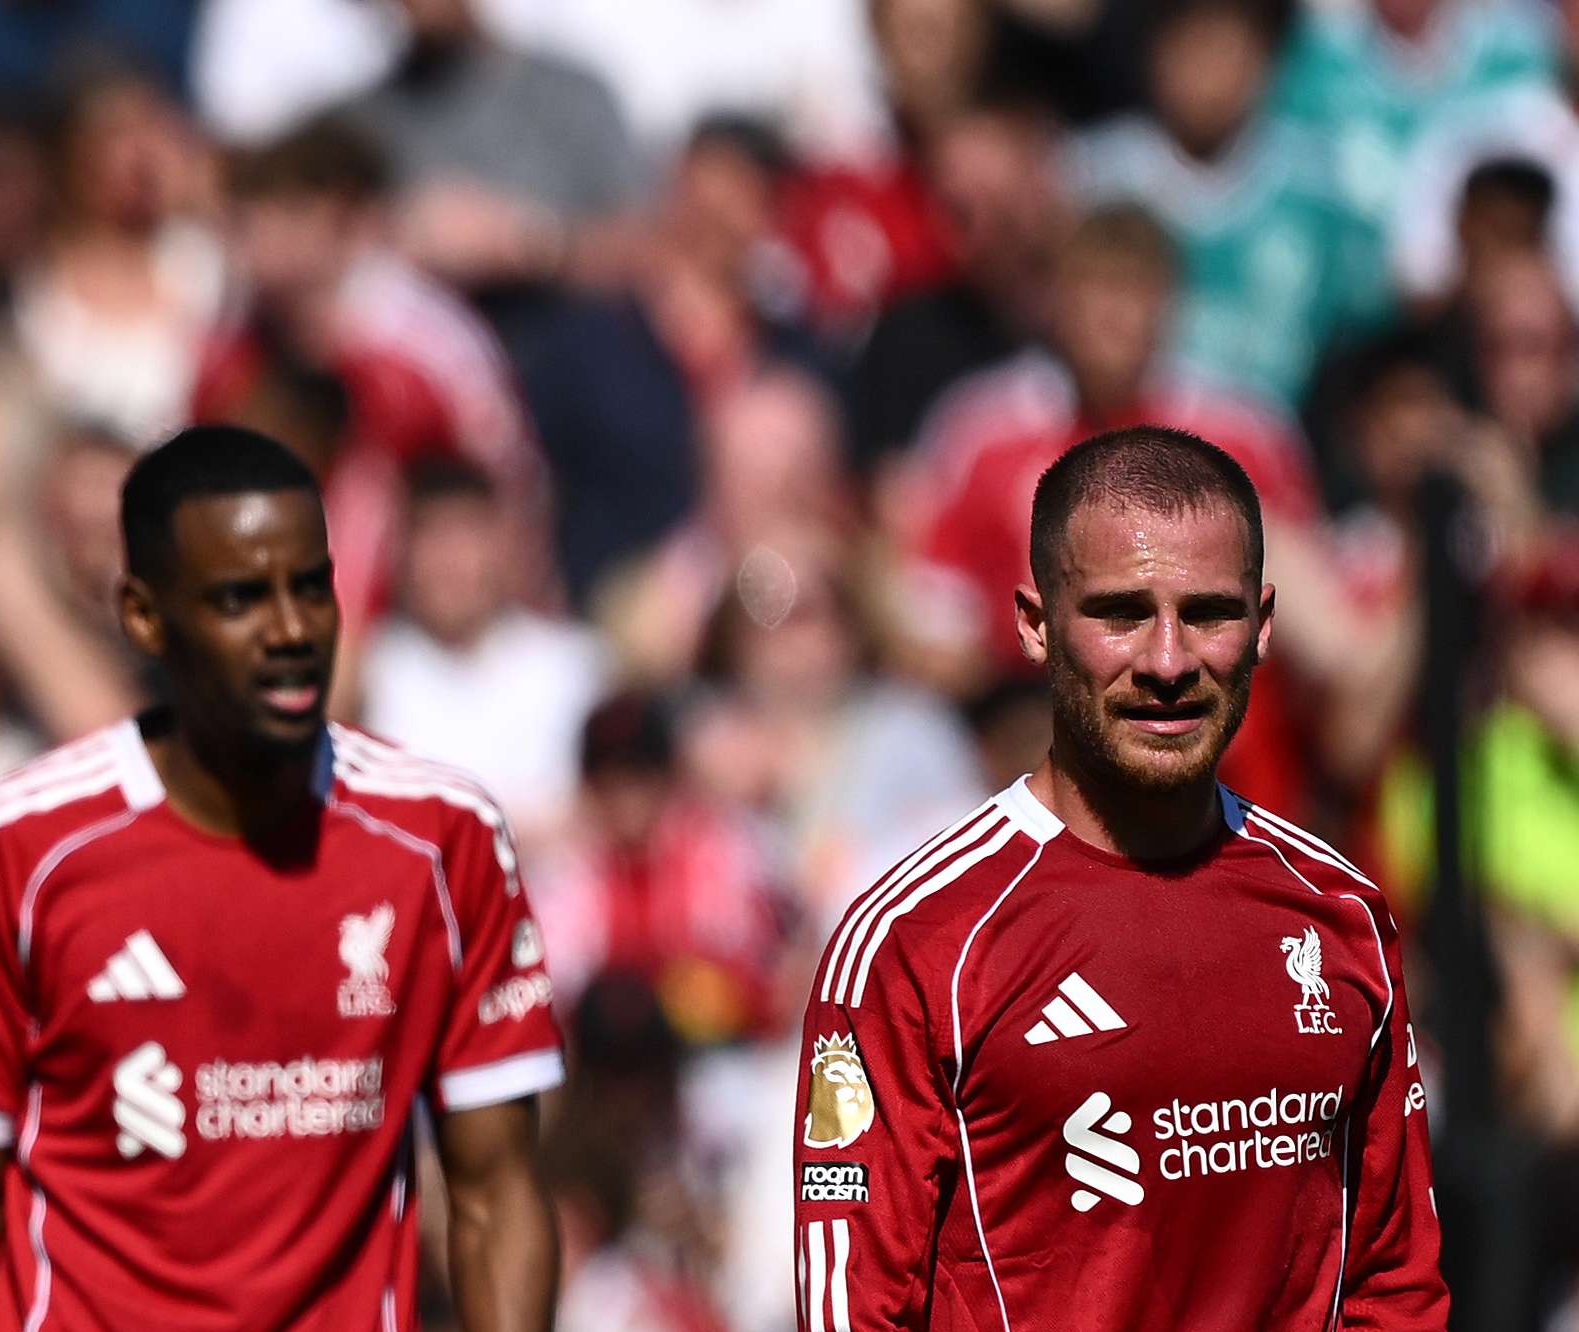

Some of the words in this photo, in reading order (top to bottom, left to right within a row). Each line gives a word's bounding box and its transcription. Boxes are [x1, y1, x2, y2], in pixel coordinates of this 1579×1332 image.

[1153, 1084, 1343, 1140] standard
[804, 1166, 863, 1185] room
[1160, 1124, 1337, 1180] chartered
